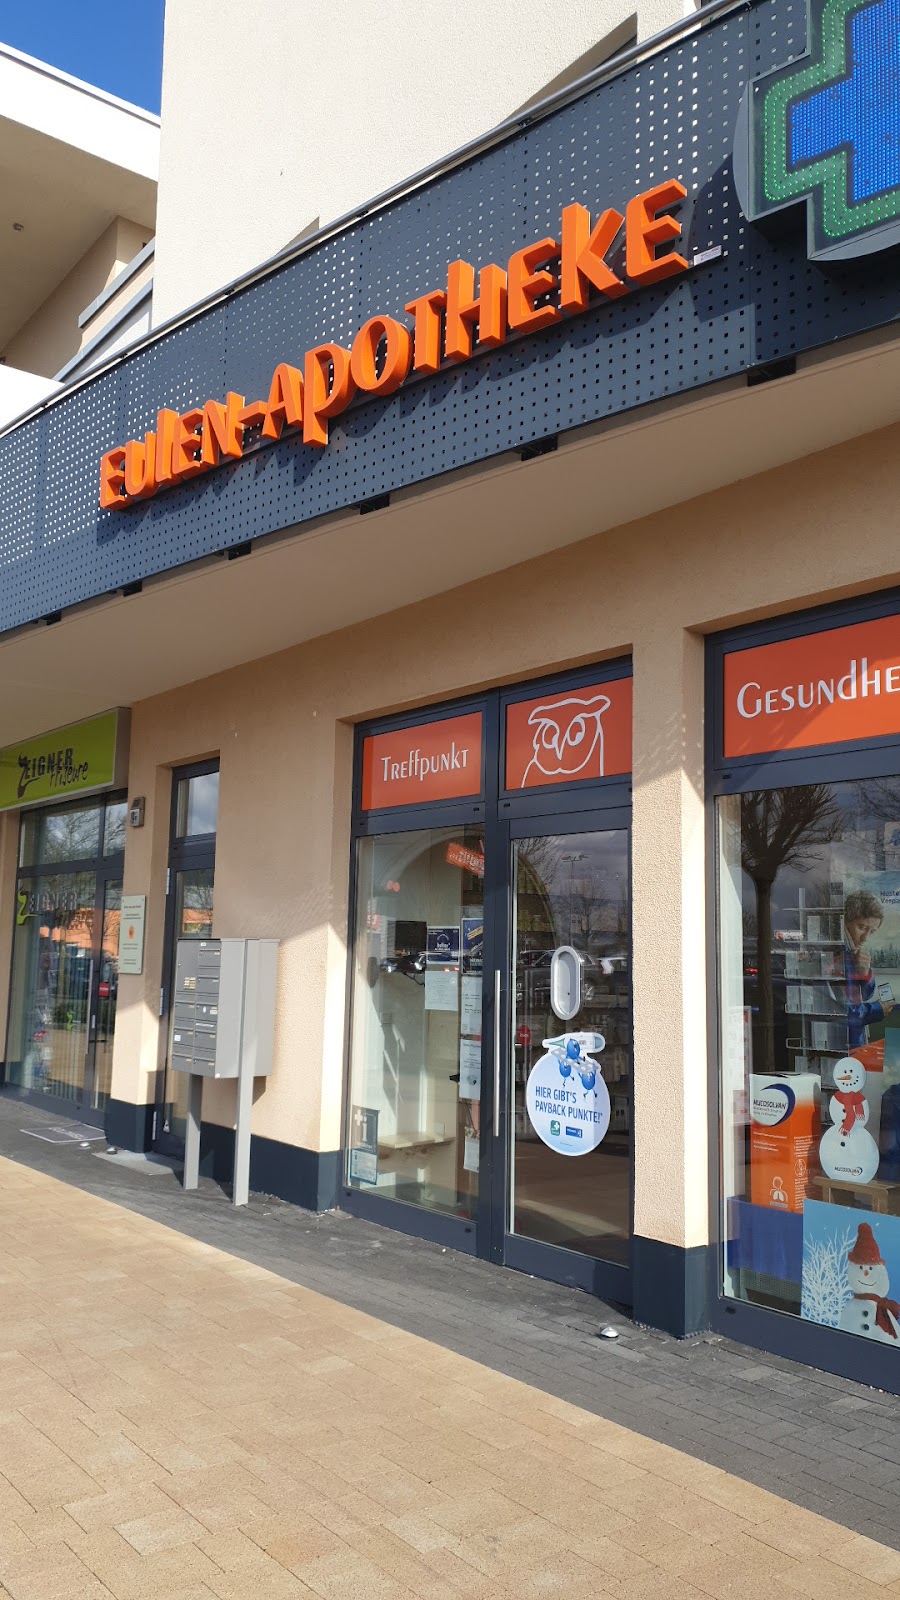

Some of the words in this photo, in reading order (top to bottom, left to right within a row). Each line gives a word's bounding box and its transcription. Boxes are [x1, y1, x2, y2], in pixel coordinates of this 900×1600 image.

[535, 1085, 552, 1100] HIER
[553, 1089, 577, 1103] GIBT'S
[535, 1100, 567, 1117] PAYBACK
